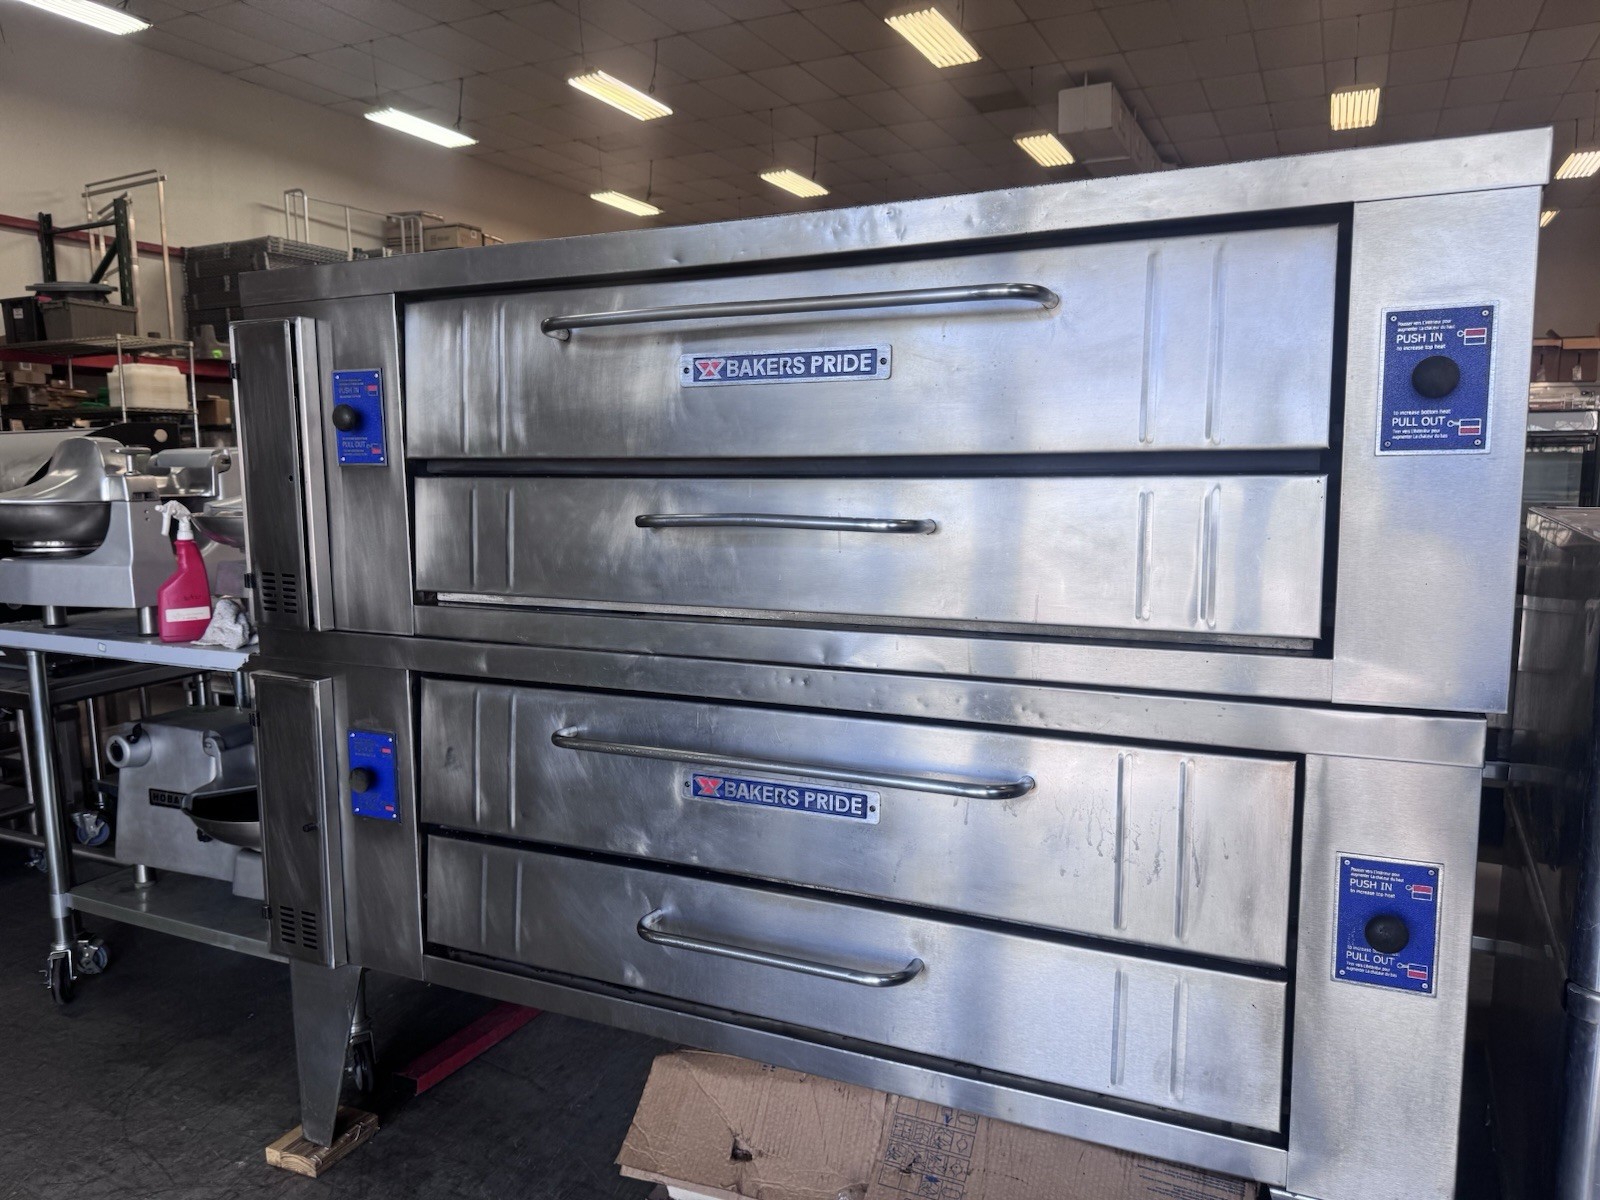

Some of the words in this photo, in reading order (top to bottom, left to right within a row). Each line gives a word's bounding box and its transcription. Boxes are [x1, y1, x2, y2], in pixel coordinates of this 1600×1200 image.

[1397, 334, 1426, 343] PUSH
[1430, 333, 1442, 342] IN
[726, 357, 805, 377] BAKERS
[811, 354, 872, 374] PRIDE
[1392, 418, 1418, 426] PULL
[1421, 416, 1445, 426] OUT
[153, 793, 182, 803] HOBA
[724, 782, 799, 806] BAKERS
[804, 792, 862, 814] PRIDE
[1350, 878, 1377, 889] PUSH
[1381, 882, 1392, 891] IN
[1346, 951, 1370, 962] PULL
[1373, 955, 1395, 965] OUT
